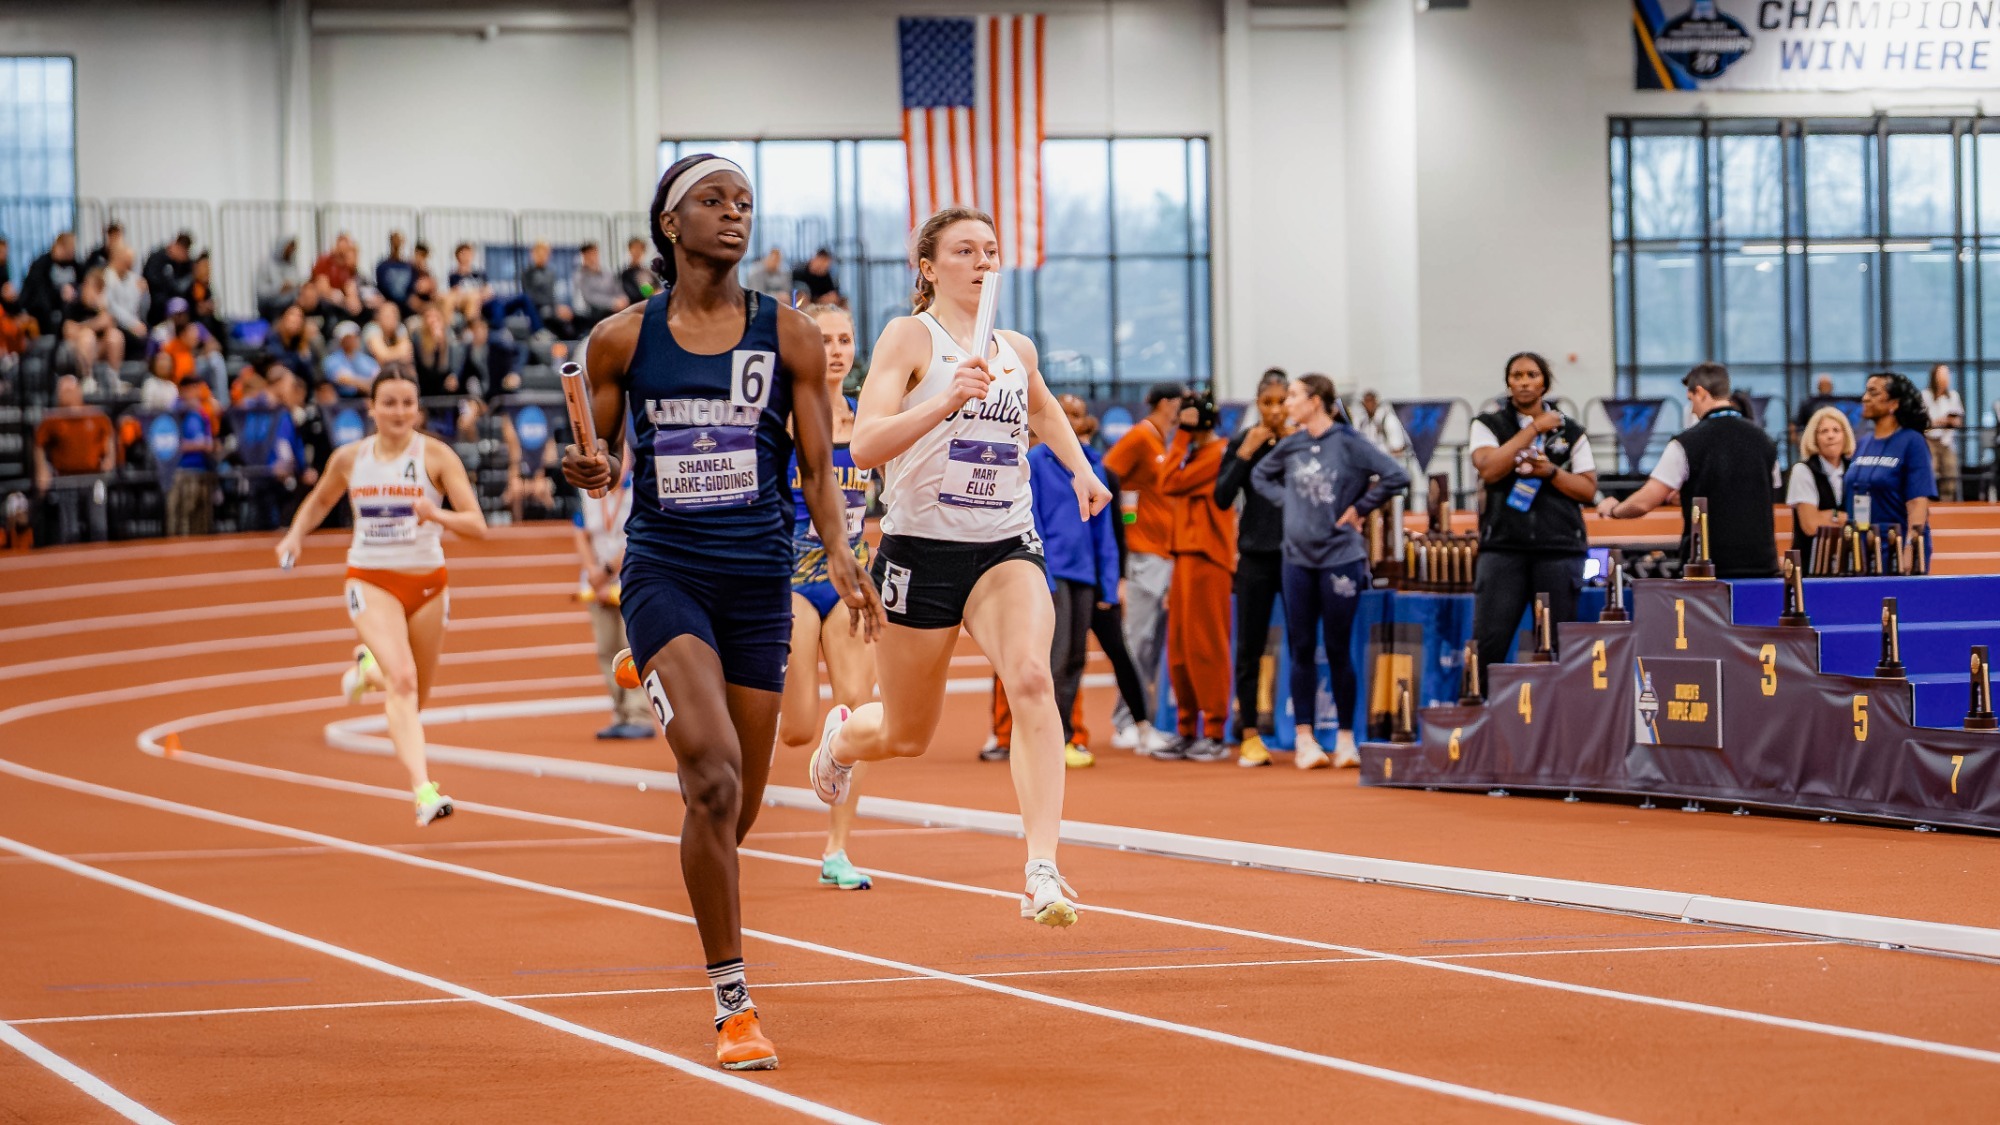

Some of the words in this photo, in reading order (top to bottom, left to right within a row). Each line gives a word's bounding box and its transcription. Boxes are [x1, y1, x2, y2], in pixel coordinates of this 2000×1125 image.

[1757, 0, 2000, 30] CHAMPION
[1781, 40, 1865, 70] WIN
[1884, 40, 1990, 70] HERE
[741, 353, 765, 404] 6
[645, 398, 762, 426] LINCOLN
[662, 471, 754, 494] CLARKE-GIDDINGS
[679, 457, 735, 474] SHANEAL
[972, 467, 998, 480] MARY
[965, 481, 996, 497] ELLIS
[884, 567, 902, 608] 5
[1674, 599, 1688, 649] 1
[1592, 640, 1608, 690] 2
[1759, 644, 1777, 696] 3
[1518, 683, 1532, 724] 4
[1853, 695, 1868, 741] 5
[1448, 728, 1462, 760] 6
[1951, 755, 1964, 794] 7
